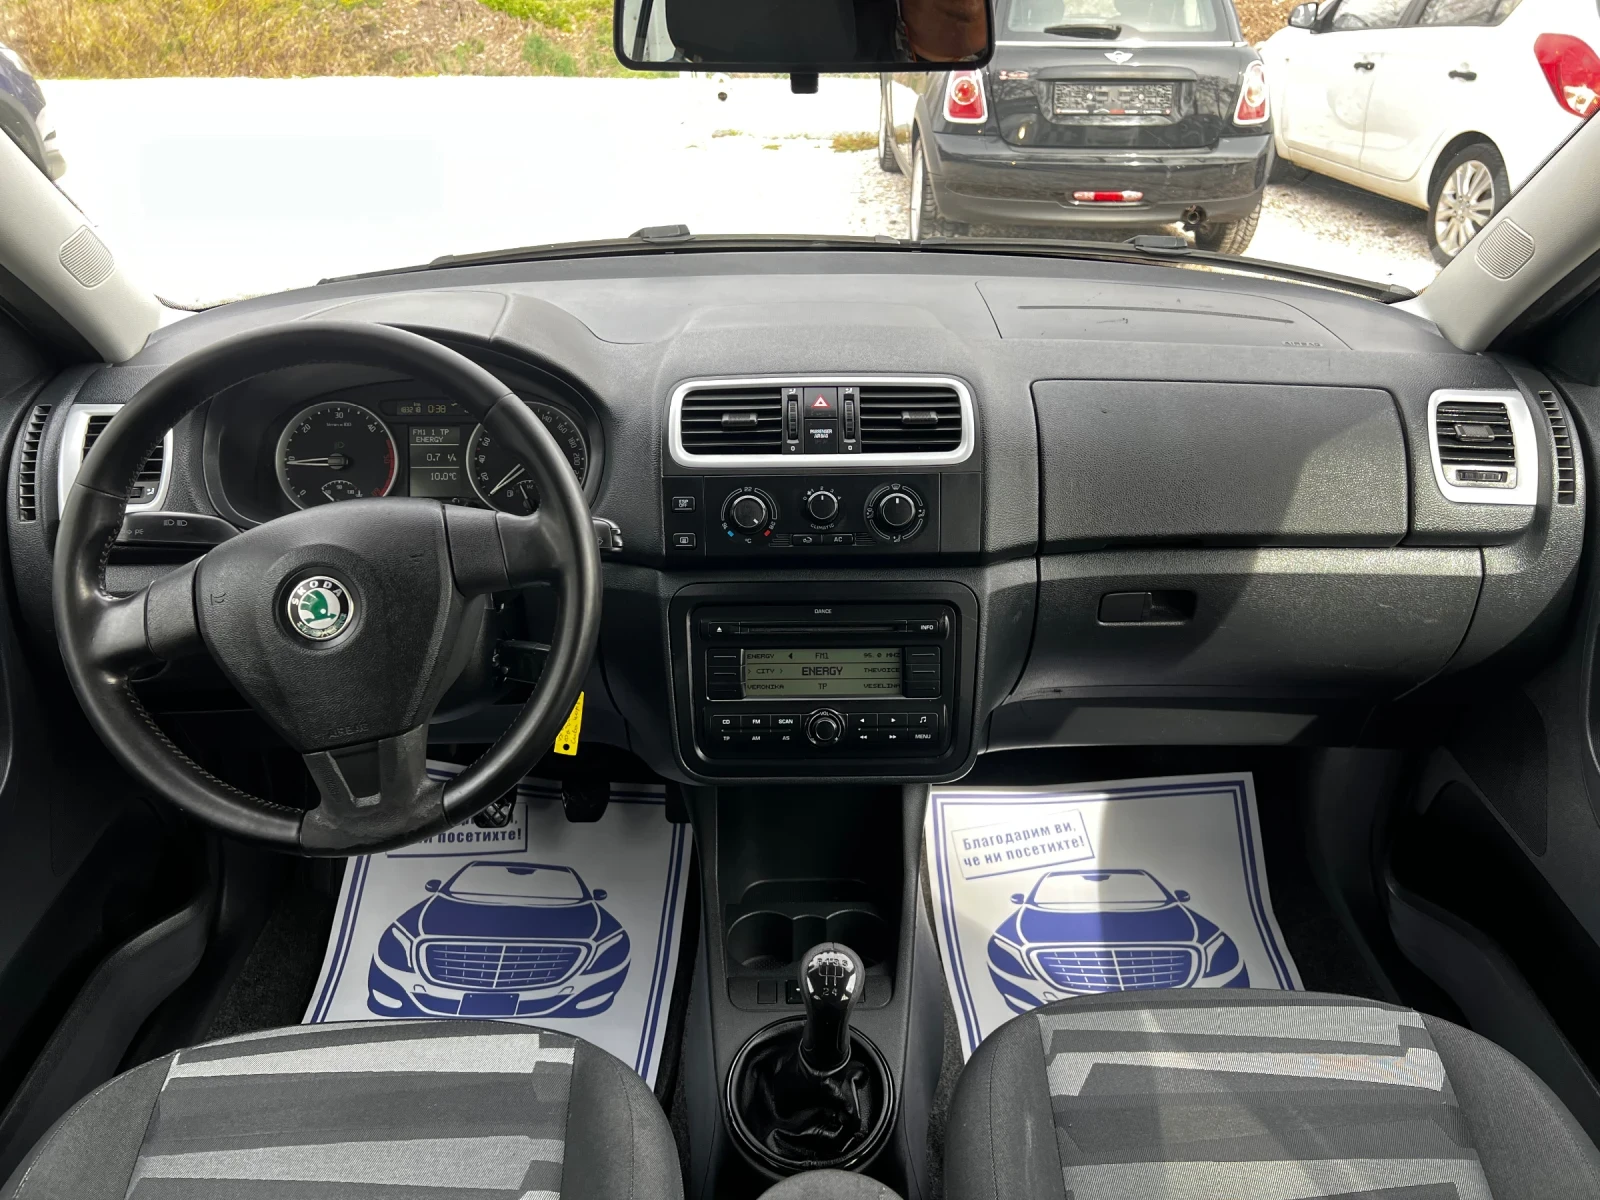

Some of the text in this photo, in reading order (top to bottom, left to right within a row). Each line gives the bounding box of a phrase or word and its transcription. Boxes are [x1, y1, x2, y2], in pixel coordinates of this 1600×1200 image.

[427, 404, 447, 413] 0:38
[334, 411, 344, 419] 30
[541, 414, 553, 423] 140
[302, 424, 311, 433] 20
[367, 424, 377, 433] 40
[412, 428, 426, 436] FM1
[439, 428, 450, 436] TP
[556, 423, 567, 434] 160
[482, 437, 490, 447] 60
[567, 438, 577, 449] 180
[426, 453, 441, 461] 0.7
[478, 454, 486, 464] 40
[573, 452, 581, 466] 200
[480, 471, 489, 482] 20
[801, 666, 844, 676] ENERGY
[437, 828, 521, 844] посетихте!
[962, 822, 1076, 851] Благодарим ви,
[963, 835, 1085, 867] че ни посетихте!
[823, 987, 830, 996] 2
[831, 987, 838, 997] 4
